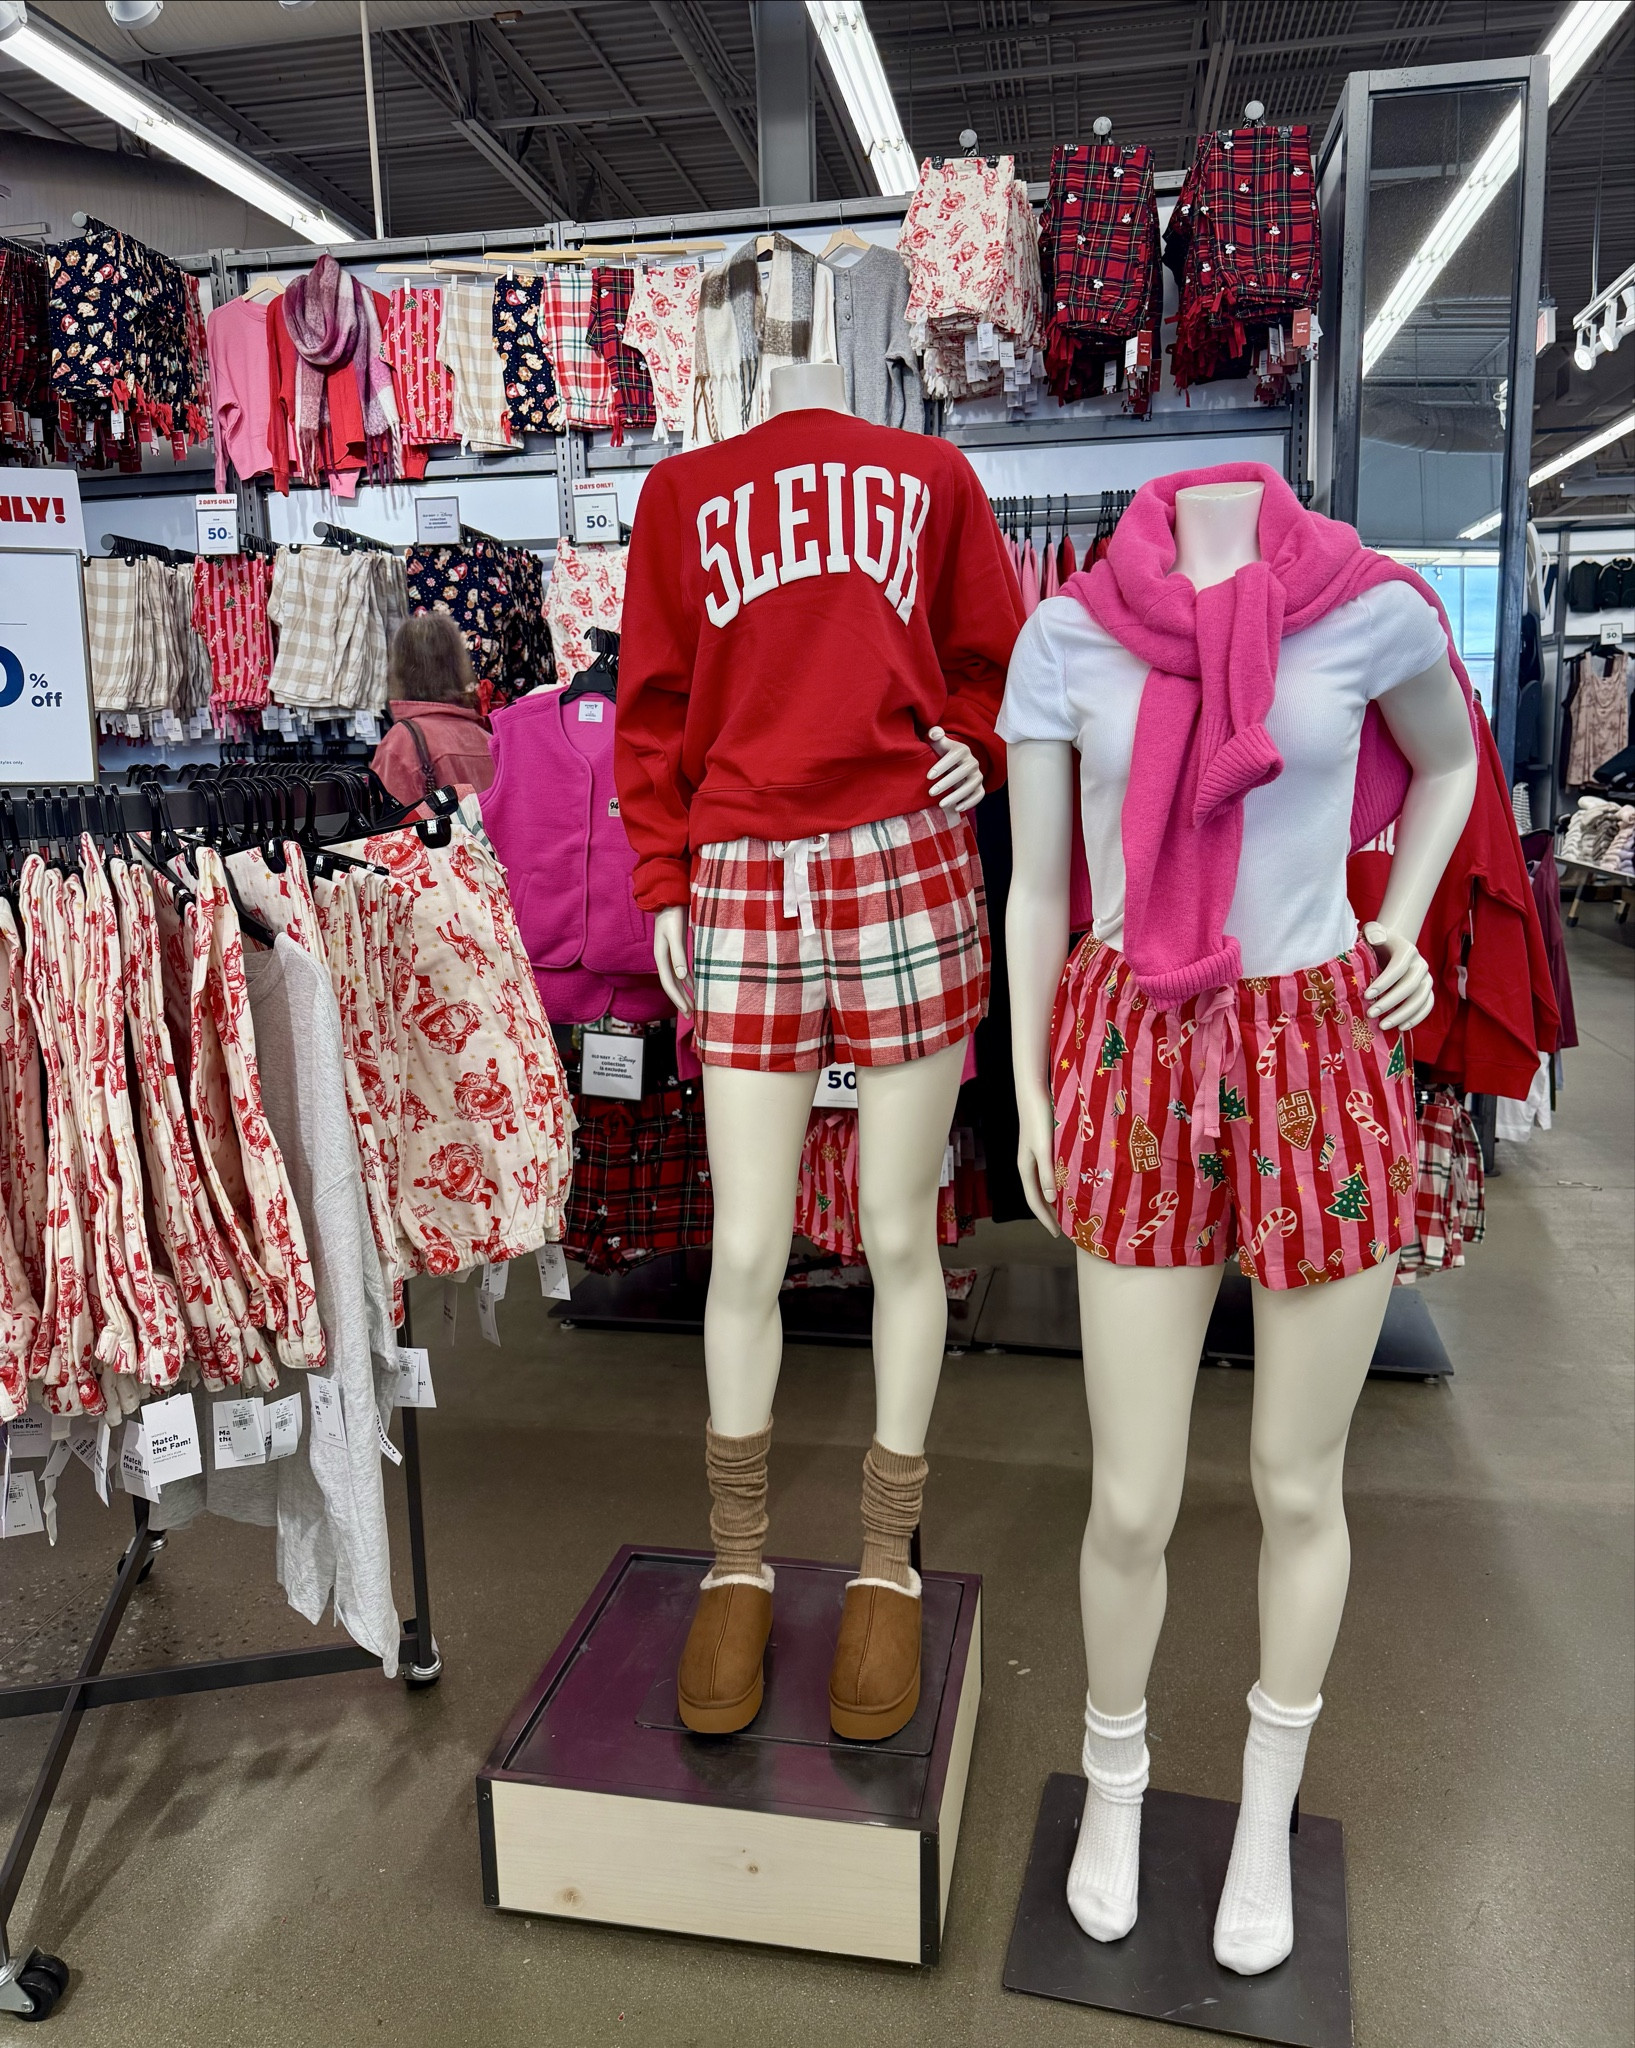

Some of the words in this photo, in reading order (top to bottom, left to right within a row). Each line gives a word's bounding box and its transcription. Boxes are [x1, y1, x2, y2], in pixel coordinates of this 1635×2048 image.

[586, 515, 607, 528] 50
[208, 527, 227, 540] 50
[697, 462, 931, 628] SLEIGH
[31, 692, 62, 707] off
[827, 1071, 857, 1090] 50
[151, 1434, 179, 1447] Match
[152, 1446, 167, 1455] the
[169, 1437, 191, 1450] Fam!
[123, 1454, 142, 1467] Match
[123, 1462, 133, 1471] the
[134, 1465, 150, 1477] Fam!
